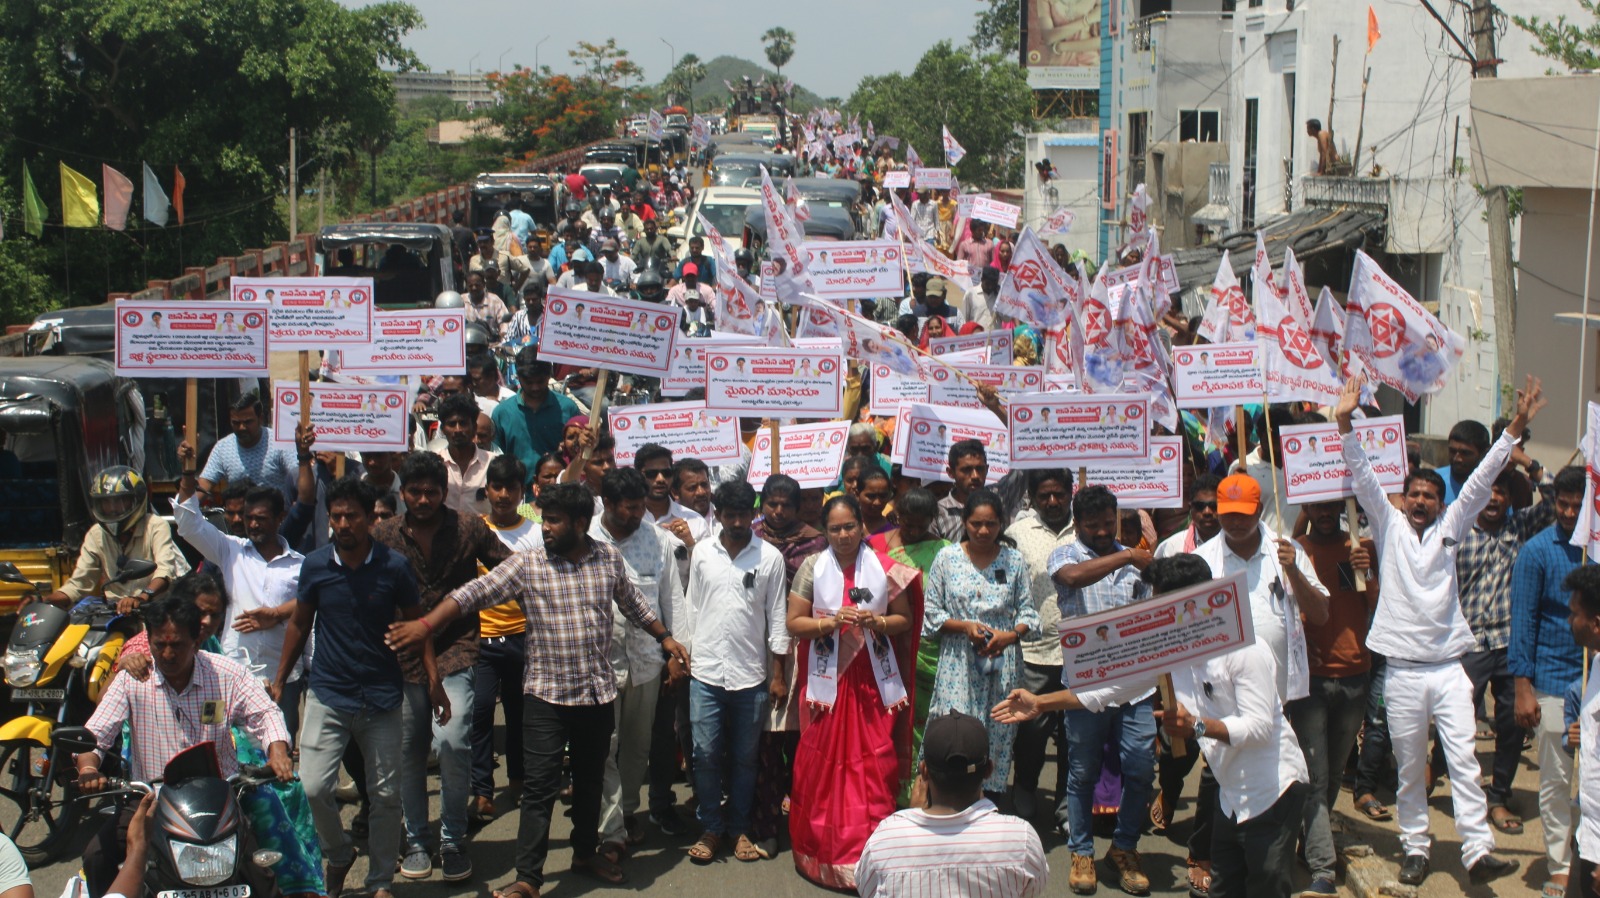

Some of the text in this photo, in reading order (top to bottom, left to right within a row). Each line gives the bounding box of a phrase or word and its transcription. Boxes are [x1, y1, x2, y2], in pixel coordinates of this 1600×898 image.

[825, 275, 876, 286] మోడల్ స్కూల్
[224, 352, 256, 363] సమస్య
[407, 353, 434, 362] సమస్య
[629, 350, 656, 362] సమస్య
[724, 385, 820, 397] మైనింగ్ మాఫియా
[1191, 381, 1244, 393] అగ్నిమాపక
[354, 425, 386, 438] కేంద్రం
[701, 444, 735, 455] సమస్యలు
[1109, 441, 1139, 451] సమస్య
[1290, 472, 1321, 486] ప్రధాన
[1138, 481, 1169, 492] సమస్య
[1116, 612, 1152, 630] జనసేన
[1137, 646, 1189, 663] మంజూరు
[1191, 635, 1230, 647] సమస్య
